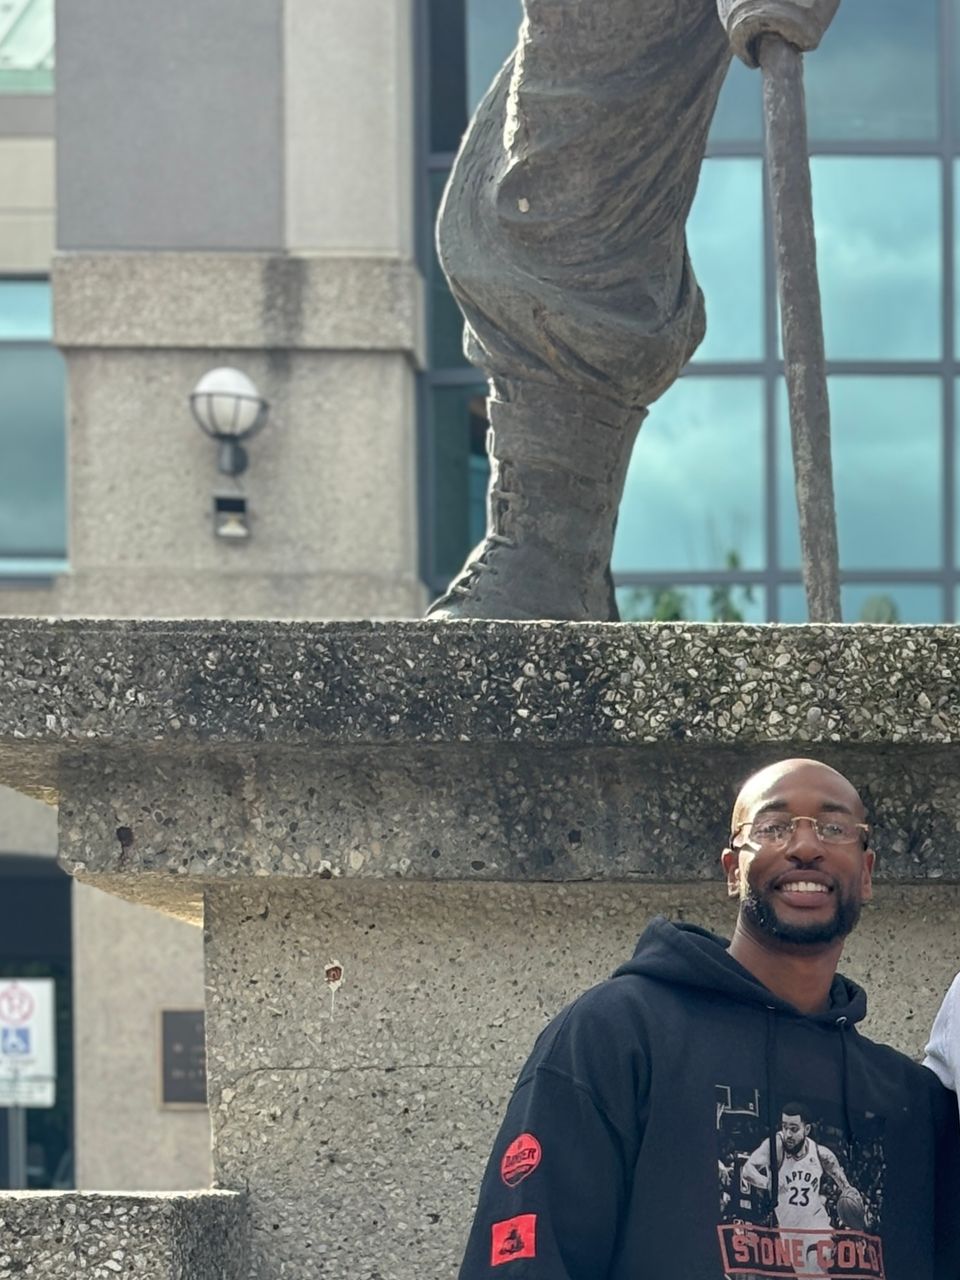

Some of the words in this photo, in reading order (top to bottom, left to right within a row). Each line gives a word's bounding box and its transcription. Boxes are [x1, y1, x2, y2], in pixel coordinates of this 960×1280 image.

[788, 1186, 811, 1207] 23
[731, 1234, 805, 1268] STONE
[816, 1238, 880, 1272] COLD
